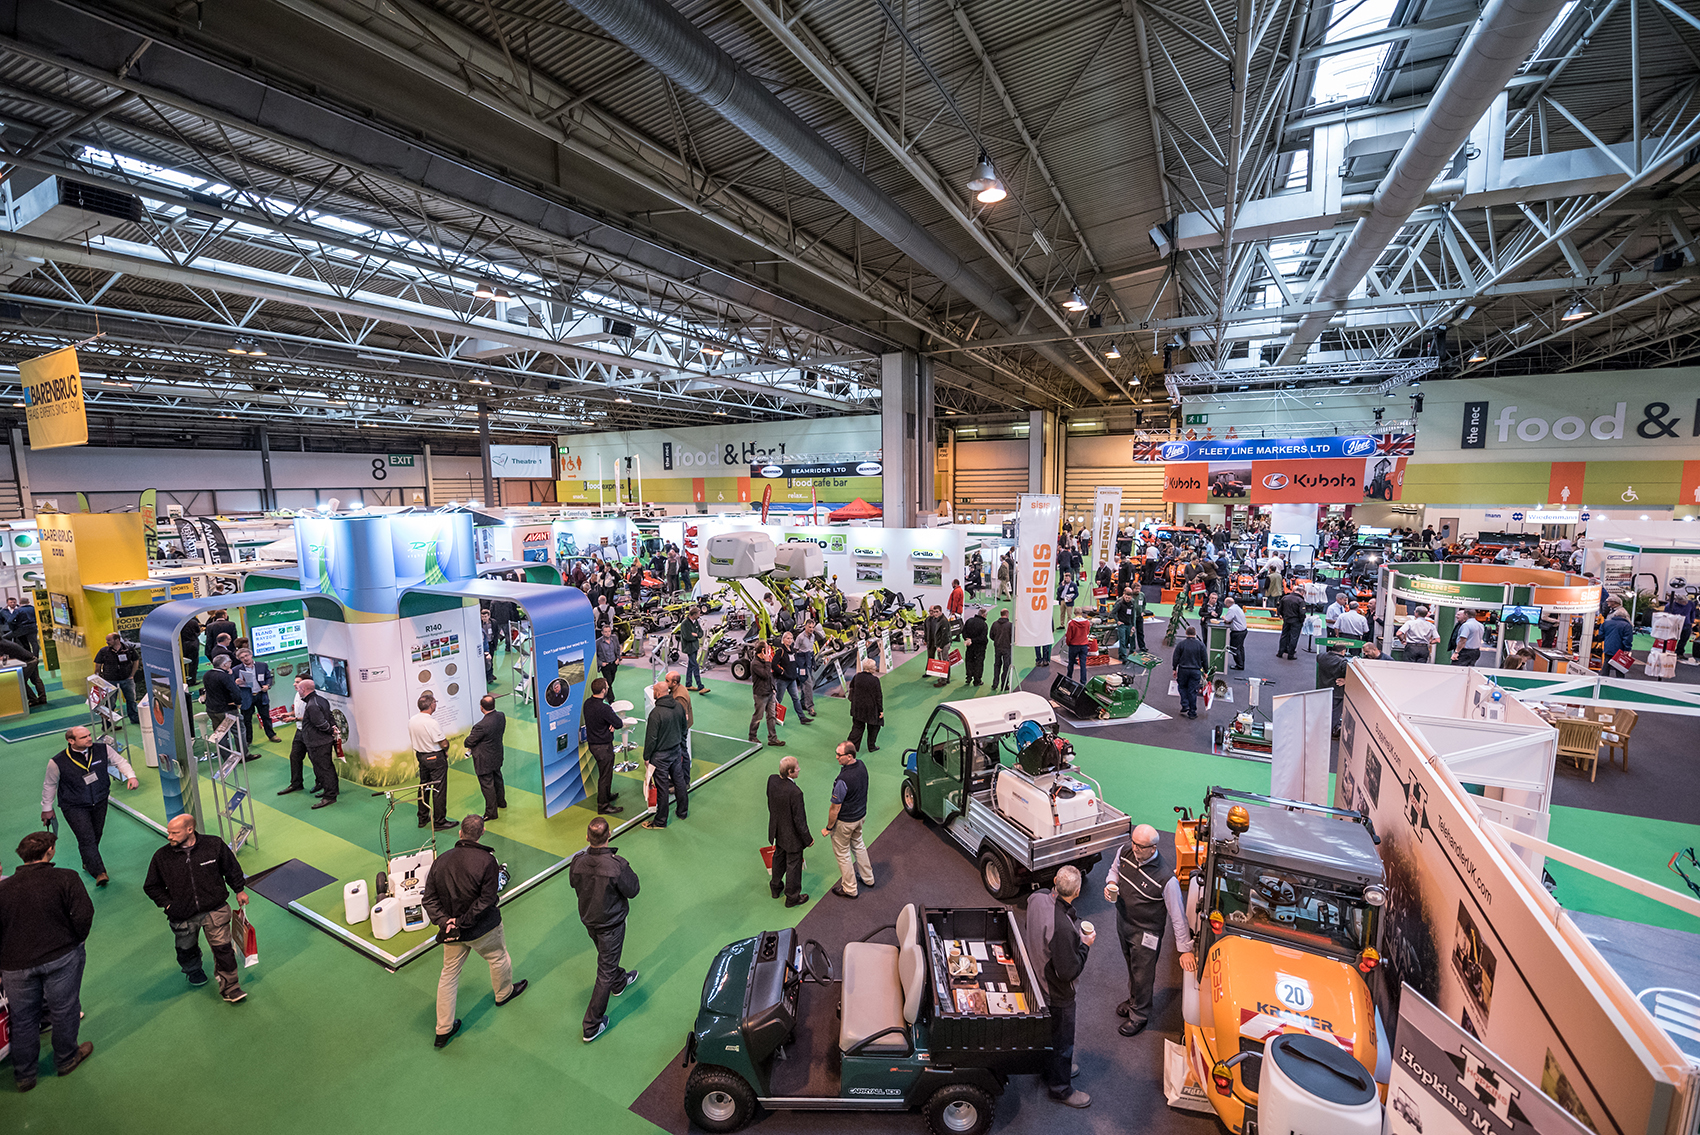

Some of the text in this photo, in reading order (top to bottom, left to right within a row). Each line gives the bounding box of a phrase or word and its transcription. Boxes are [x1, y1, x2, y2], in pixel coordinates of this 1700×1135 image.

[31, 374, 77, 406] BARENBRUG
[1467, 406, 1481, 444] the nec
[1494, 402, 1681, 442] food &
[674, 444, 719, 466] food
[724, 444, 739, 465] &
[1256, 445, 1307, 454] MARKERS
[1311, 444, 1330, 453] LTD
[372, 458, 387, 480] 8
[390, 456, 412, 465] EXIT
[602, 483, 624, 491] exprss
[792, 478, 848, 486] food cafe bar
[1170, 477, 1200, 489] Kubota
[1294, 474, 1355, 487] Kubota
[525, 531, 551, 542] AVANT
[1101, 503, 1113, 562] DENNIS
[1411, 580, 1460, 593] DENNIS
[426, 623, 442, 632] R140
[1438, 815, 1492, 905] TelehandlerUK.com
[1284, 984, 1304, 1006] 20
[1257, 1002, 1334, 1032] KRAMER
[1400, 1045, 1468, 1117] Hopkins
[1466, 1066, 1507, 1106] HOPKINS
